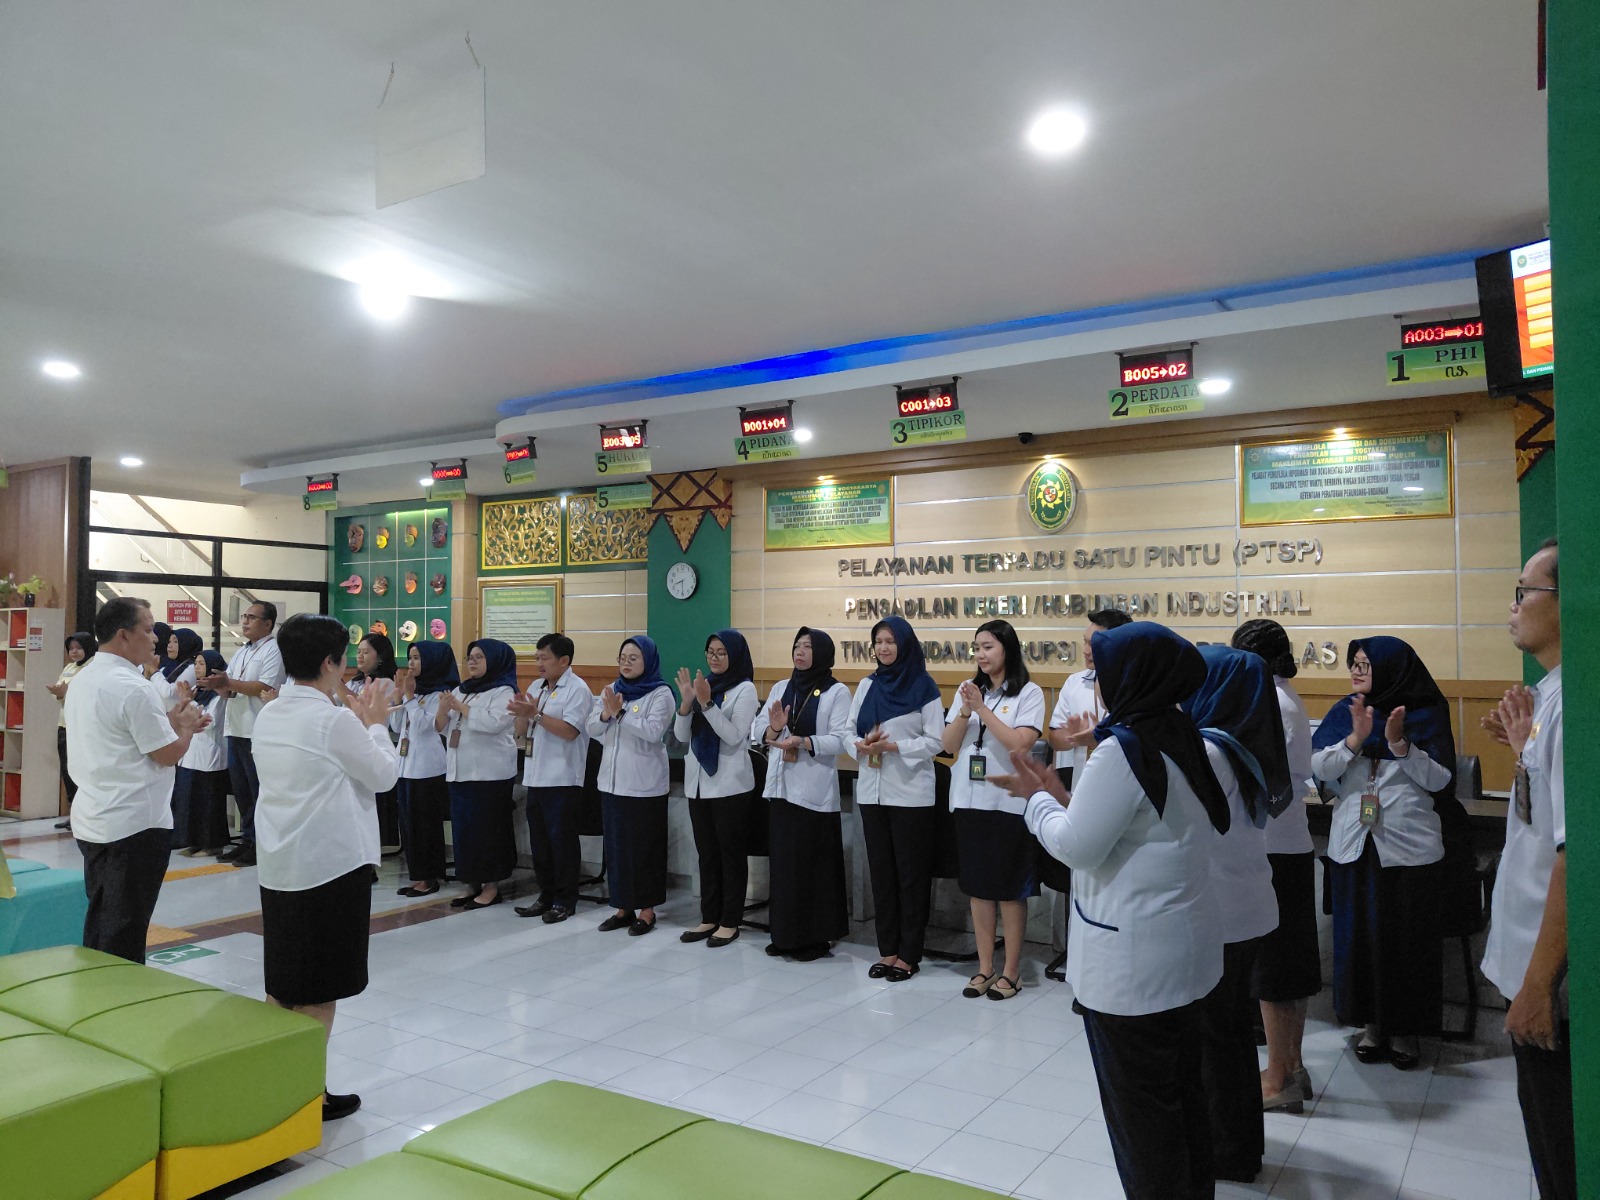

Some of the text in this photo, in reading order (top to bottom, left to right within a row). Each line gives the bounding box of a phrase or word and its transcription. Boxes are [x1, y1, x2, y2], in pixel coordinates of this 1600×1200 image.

[1391, 346, 1477, 382] 1 PHI
[1111, 383, 1200, 417] 2 PERDATA
[893, 414, 962, 444] 3 TIPIKOR
[738, 435, 795, 460] 4 PIDANA
[504, 467, 512, 484] 6
[597, 455, 608, 473] 5
[304, 496, 311, 511] 8
[598, 490, 609, 508] 5
[838, 538, 1323, 578] PELAYANAN TERPADU SATU PINTU (PTSP)
[963, 594, 1027, 617] NEGERI
[1167, 590, 1311, 615] INDUSTRIAL
